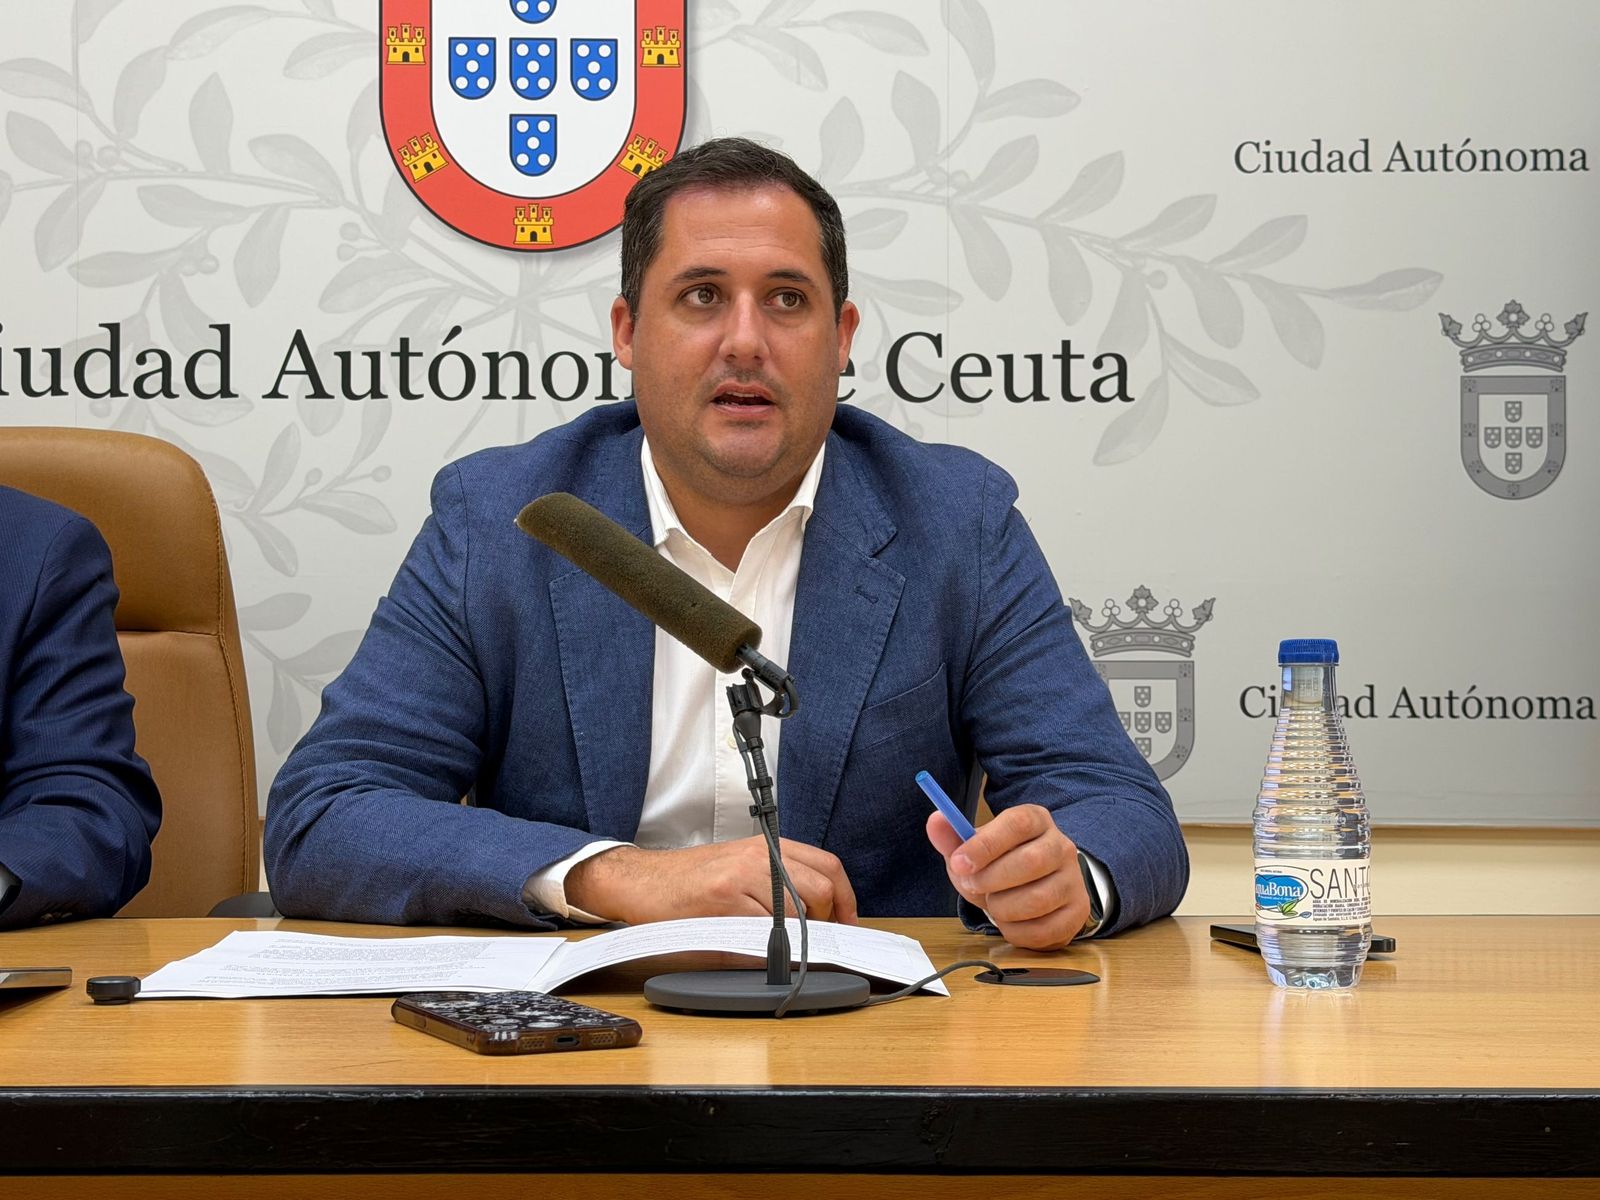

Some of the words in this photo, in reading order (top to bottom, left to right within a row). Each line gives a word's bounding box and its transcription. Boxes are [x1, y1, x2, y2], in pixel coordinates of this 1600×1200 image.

[1234, 138, 1372, 174] Ciudad
[1382, 138, 1590, 173] Autónoma
[0, 322, 239, 400] udad
[886, 331, 1135, 404] Ceuta
[1239, 684, 1378, 719] Ciad
[1388, 684, 1598, 720] Autónoma
